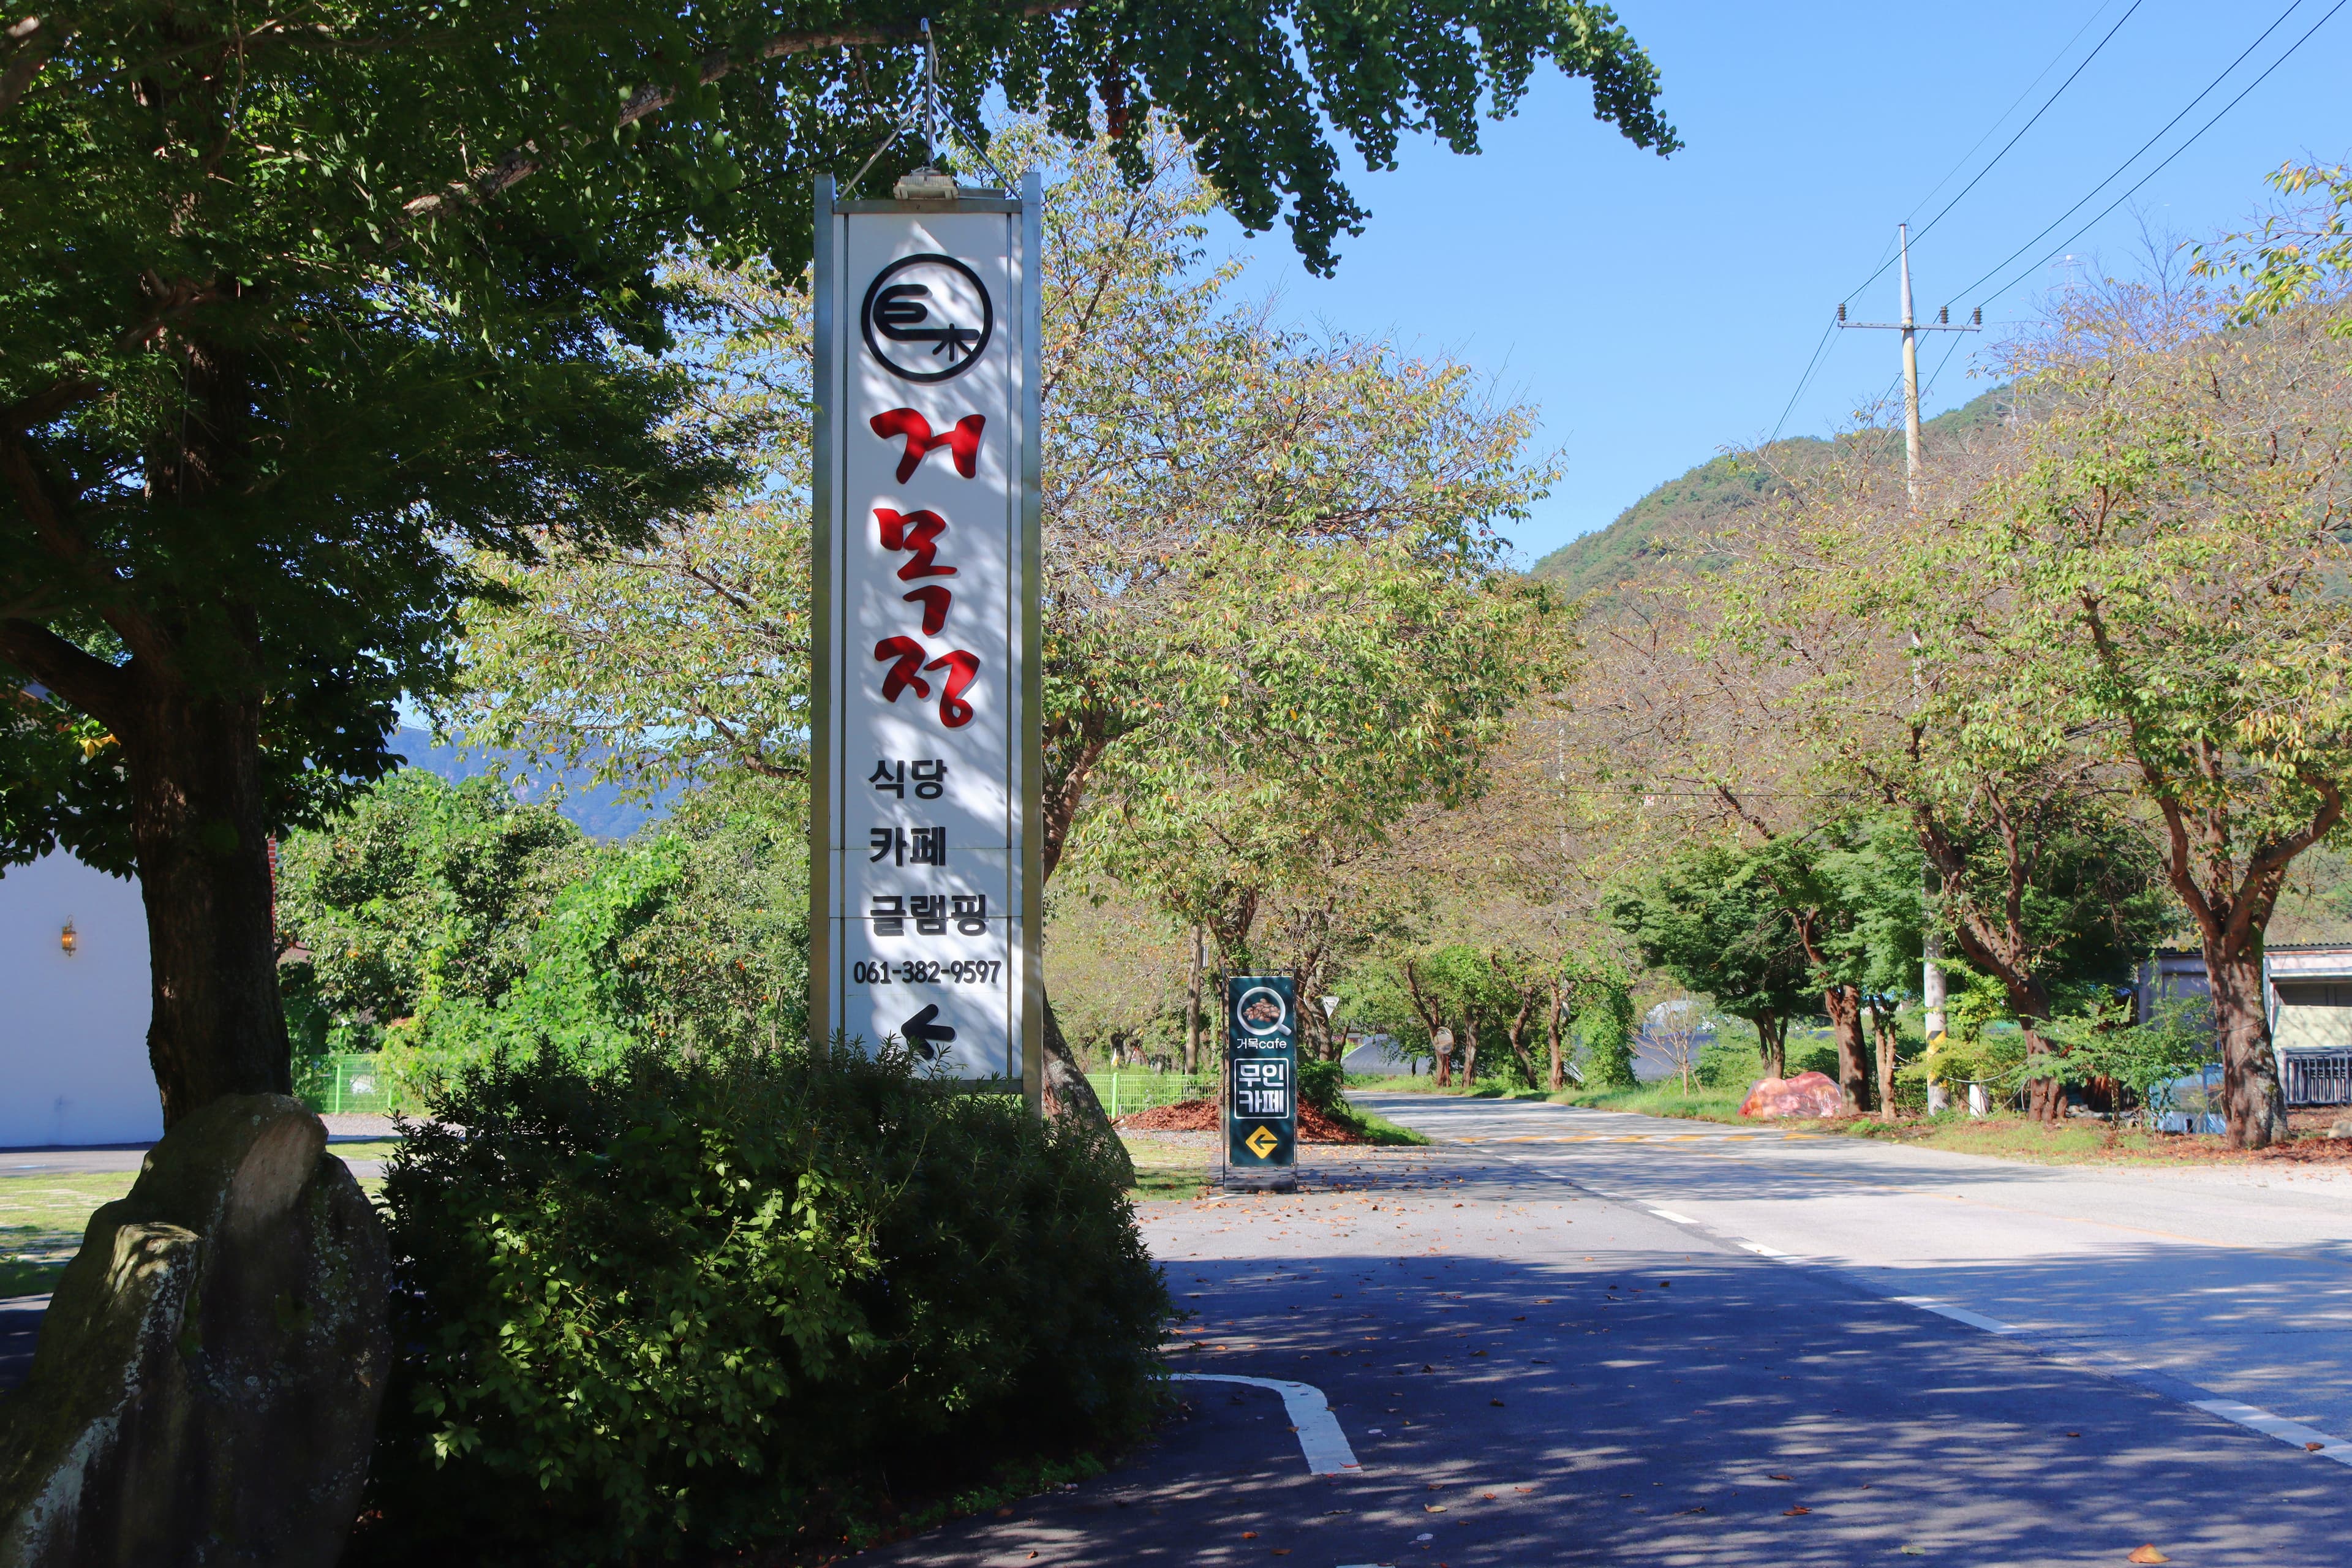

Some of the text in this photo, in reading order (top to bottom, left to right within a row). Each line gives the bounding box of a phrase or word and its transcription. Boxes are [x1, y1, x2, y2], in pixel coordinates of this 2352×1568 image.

[870, 408, 986, 728] 거목정
[868, 759, 948, 800] 식당
[869, 826, 946, 867] 카페
[870, 894, 987, 935] 글램핑
[853, 960, 1002, 984] 061-382-9597
[1236, 1038, 1287, 1049] 거목cafe
[1238, 1064, 1284, 1087] 무인
[1238, 1090, 1284, 1113] 카페
